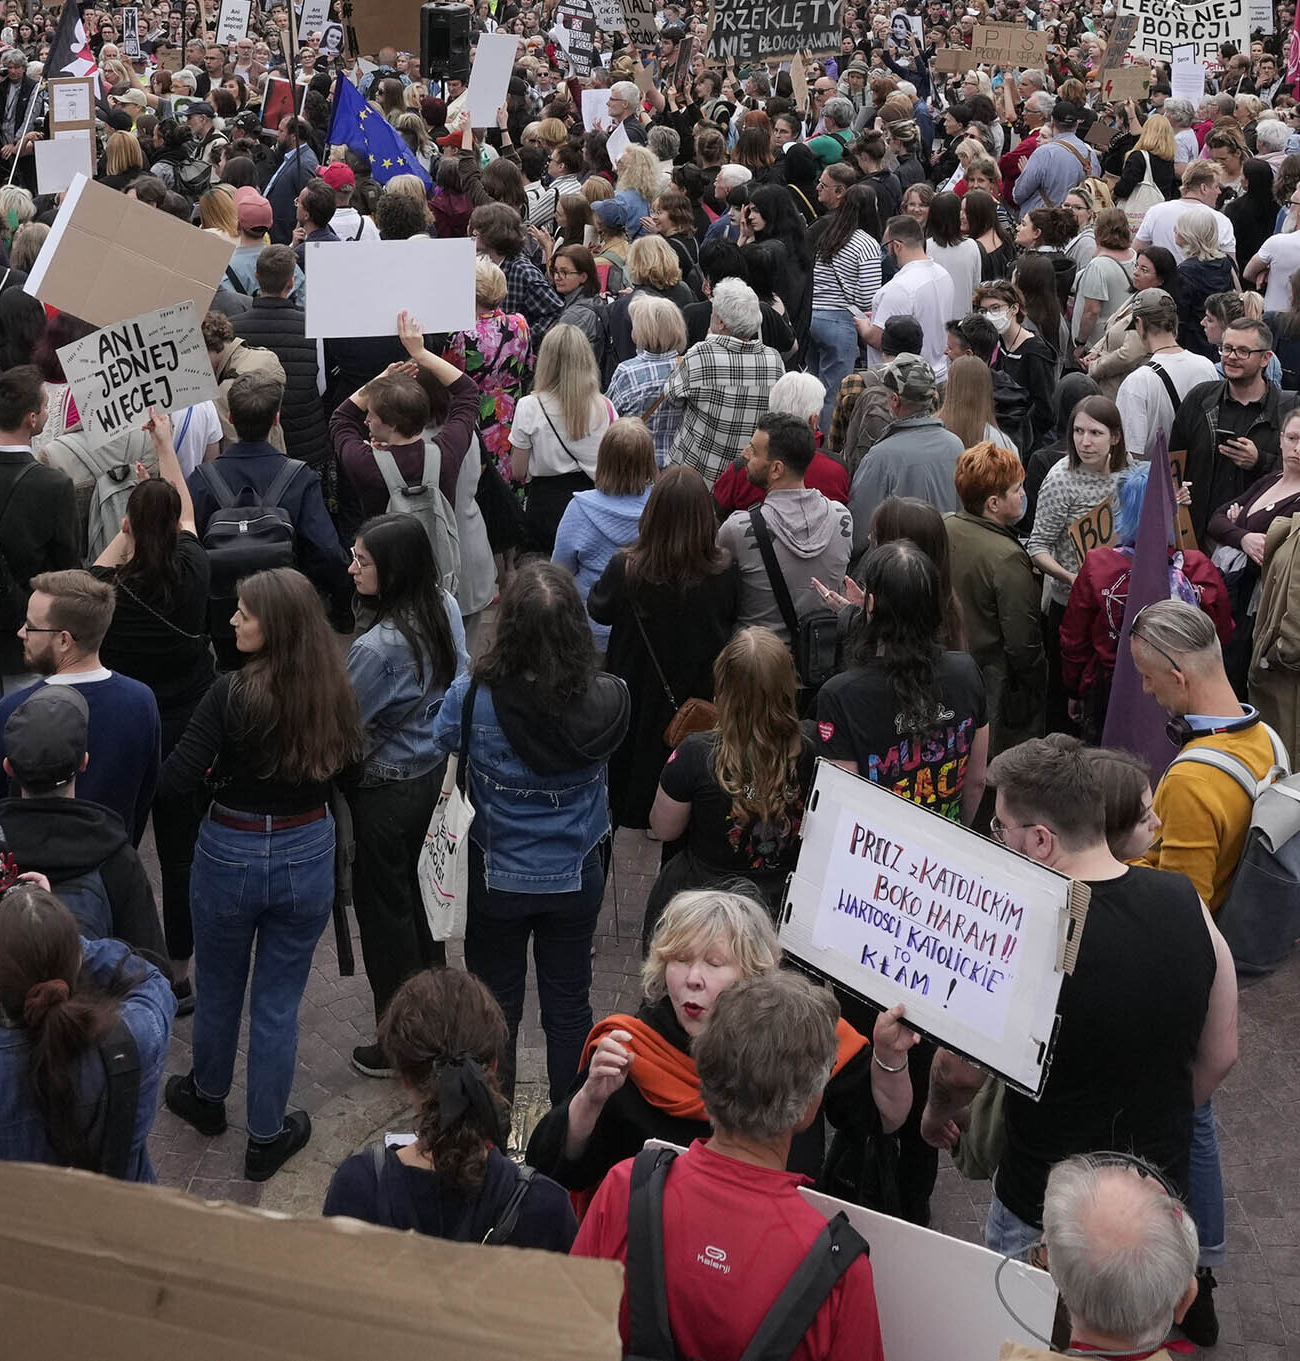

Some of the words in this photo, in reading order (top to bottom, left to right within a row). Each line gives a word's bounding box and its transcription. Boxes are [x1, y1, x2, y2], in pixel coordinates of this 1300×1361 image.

[712, 0, 841, 32] PRZEKLĘTY
[1130, 14, 1230, 40] BORCJI
[98, 323, 145, 364] ANI
[94, 340, 179, 398] JEDNEJ
[96, 376, 173, 433] WIĘCEJ
[849, 822, 904, 873] PRECZ
[872, 873, 923, 918] BOKO
[925, 900, 998, 957] HARAM
[860, 944, 931, 996] KŁAM
[893, 944, 912, 964] TO
[697, 1254, 730, 1274] Kalenji
